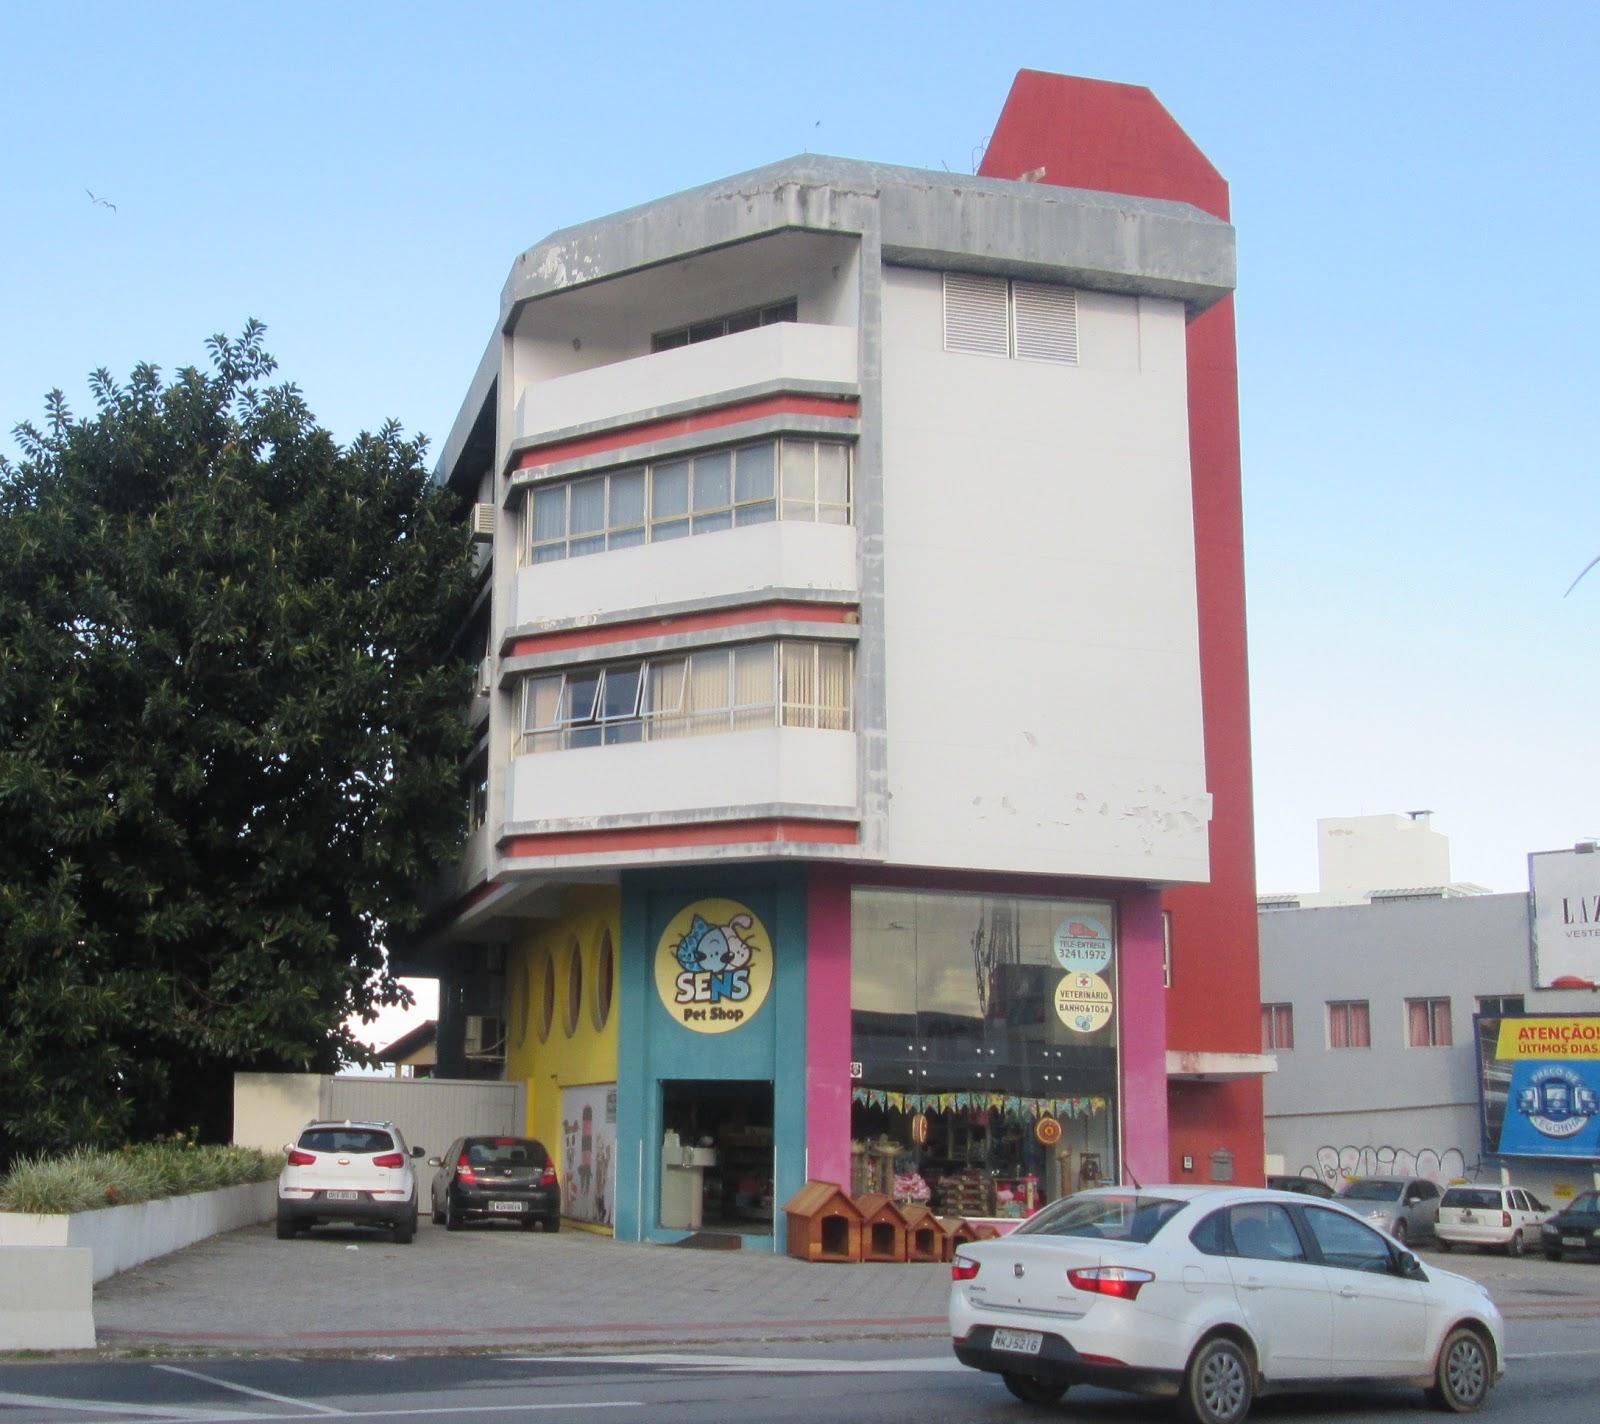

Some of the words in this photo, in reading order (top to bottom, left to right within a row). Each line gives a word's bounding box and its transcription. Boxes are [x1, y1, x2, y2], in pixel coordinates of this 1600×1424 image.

[1059, 948, 1107, 960] 3241.1972
[675, 968, 751, 1004] SENS
[1060, 989, 1109, 1000] VETERINÁRIO
[683, 1008, 707, 1021] Pet
[710, 1007, 744, 1021] Shop
[1518, 1023, 1600, 1043] ATENÇÃO!
